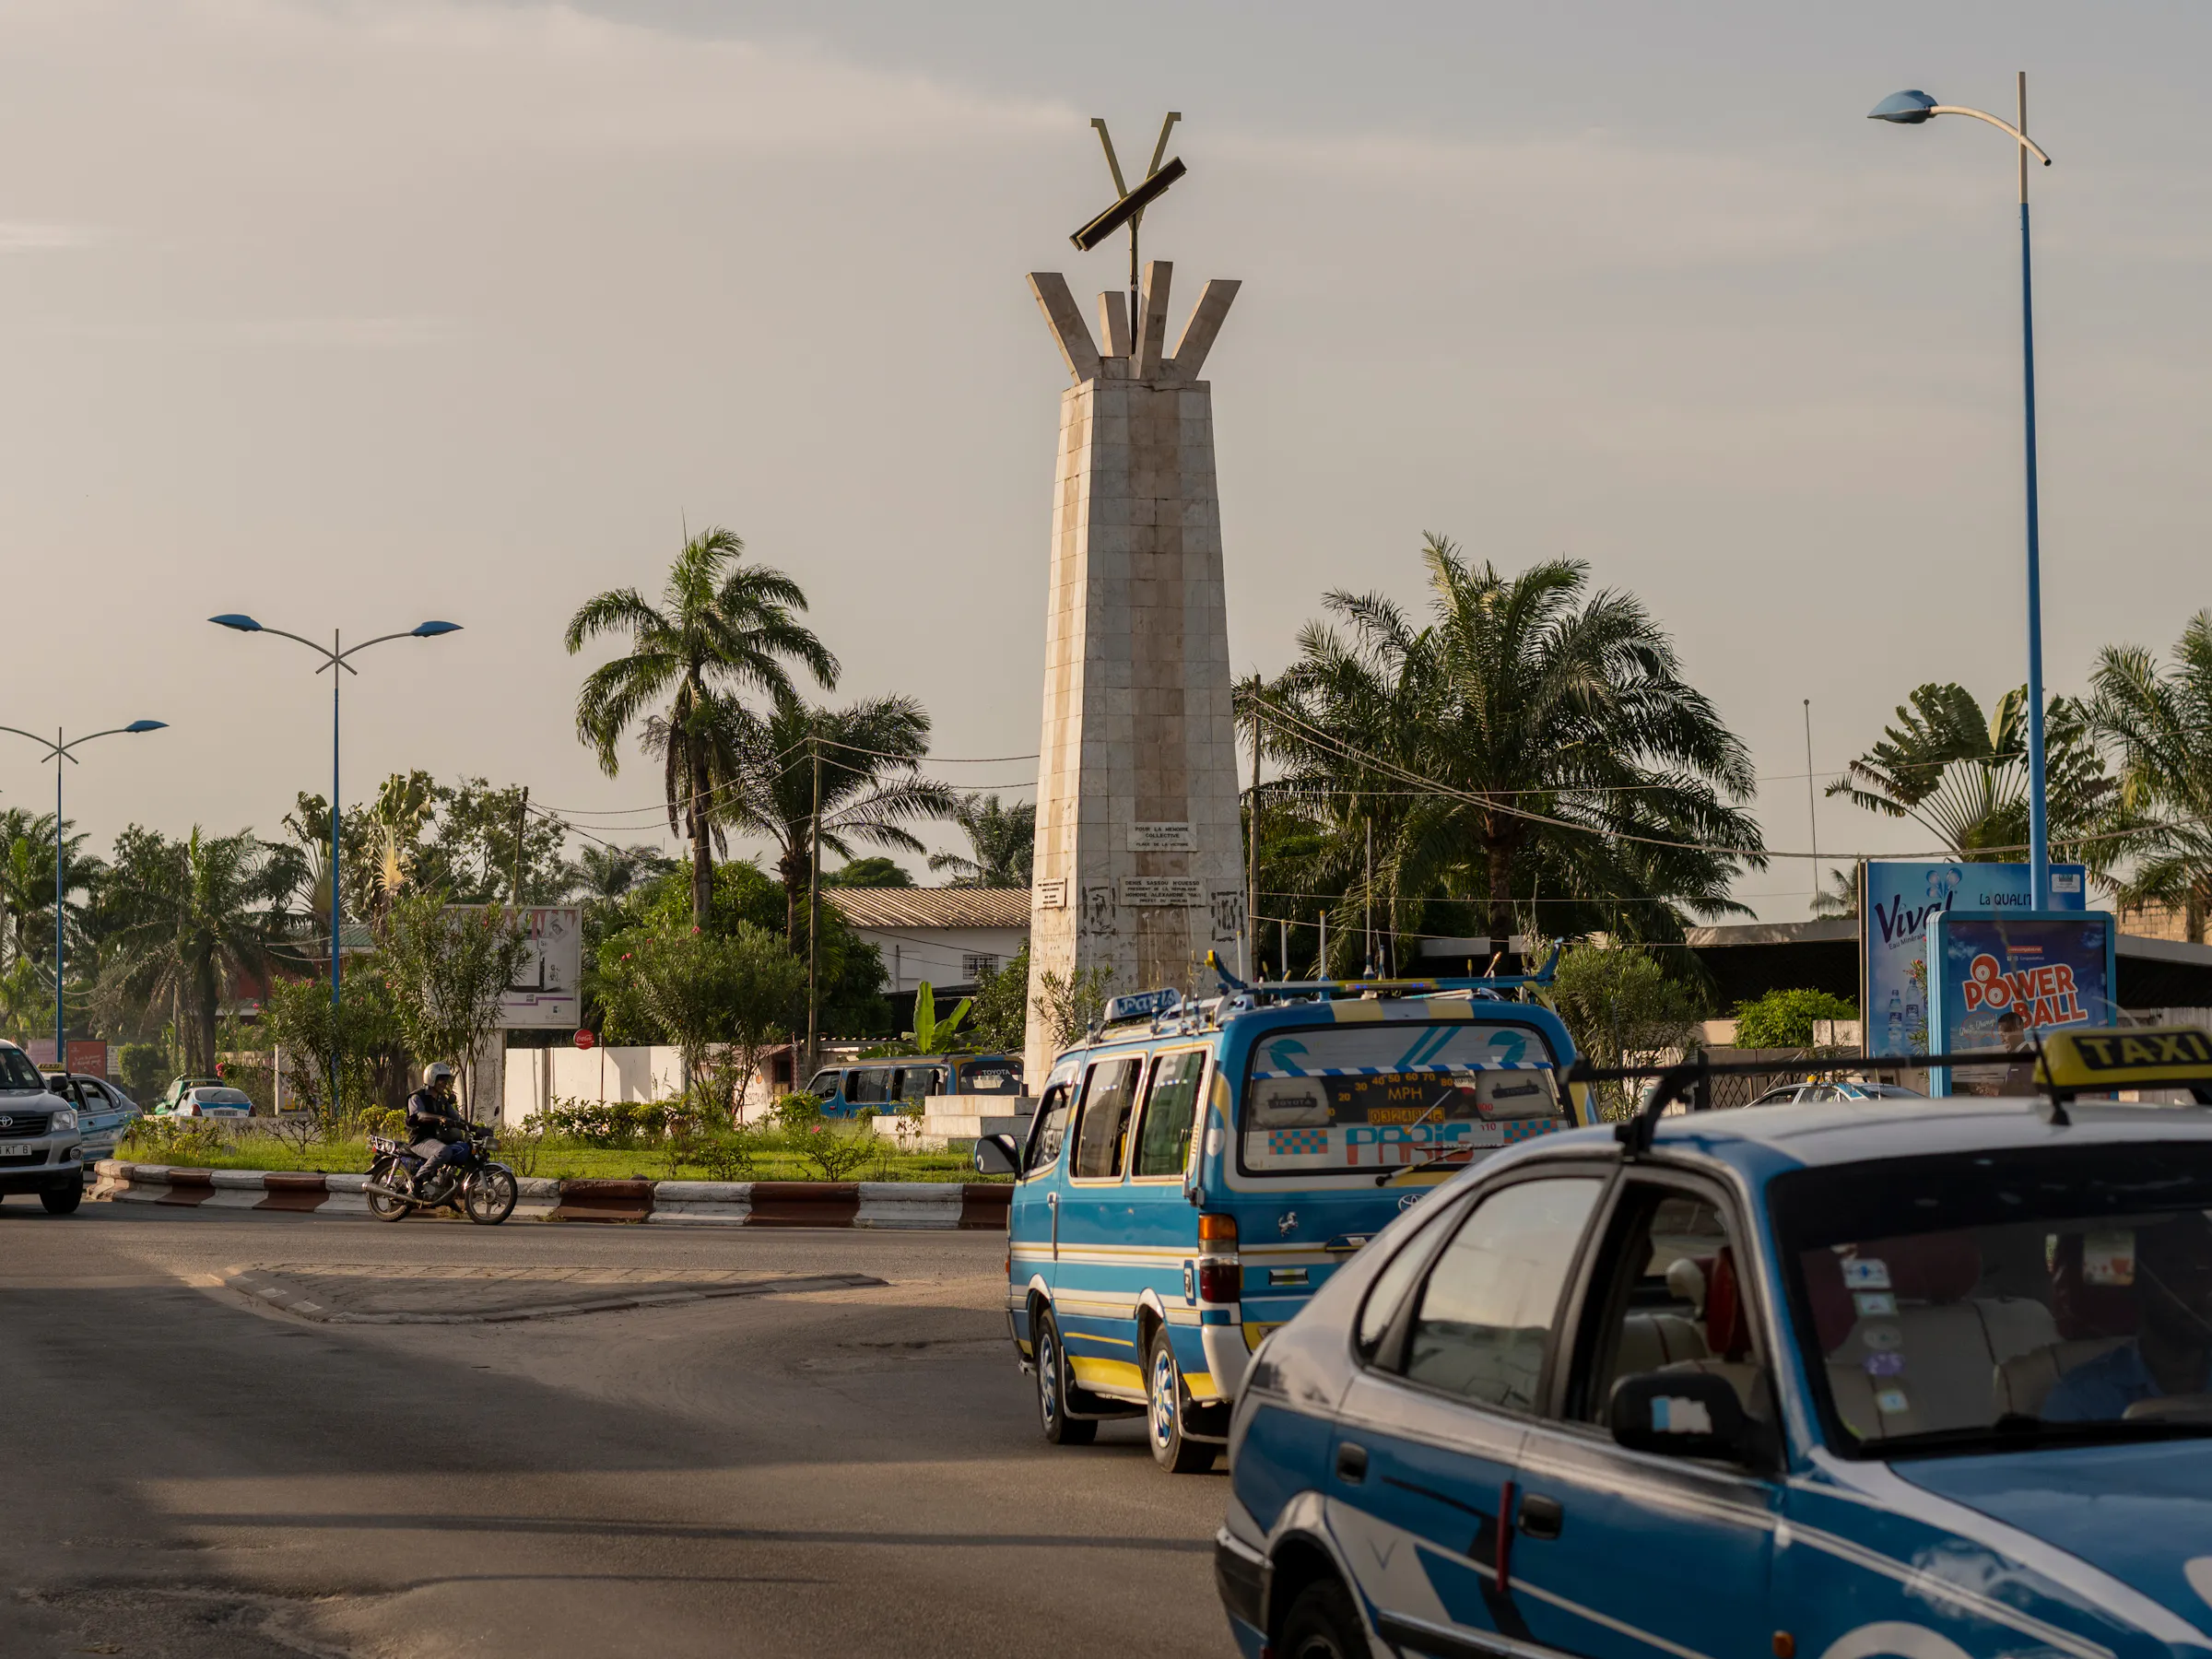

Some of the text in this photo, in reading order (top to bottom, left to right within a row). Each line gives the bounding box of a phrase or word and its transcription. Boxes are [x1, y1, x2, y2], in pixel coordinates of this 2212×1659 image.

[1980, 893, 2031, 906] La QUALIT
[1888, 942, 1900, 950] Eau
[1120, 990, 1176, 1014] Paris
[2012, 992, 2088, 1030] BALL
[2079, 1033, 2210, 1065] TAXI
[1371, 1076, 1384, 1085] 40
[1388, 1074, 1401, 1083] 50
[1405, 1073, 1418, 1081] 60
[1422, 1073, 1436, 1081] 70
[1355, 1082, 1368, 1091] 30
[1441, 1078, 1453, 1087] 80
[1338, 1092, 1351, 1101] 20
[1387, 1088, 1423, 1100] MPH
[6, 1146, 17, 1155] KT
[22, 1145, 29, 1155] 6
